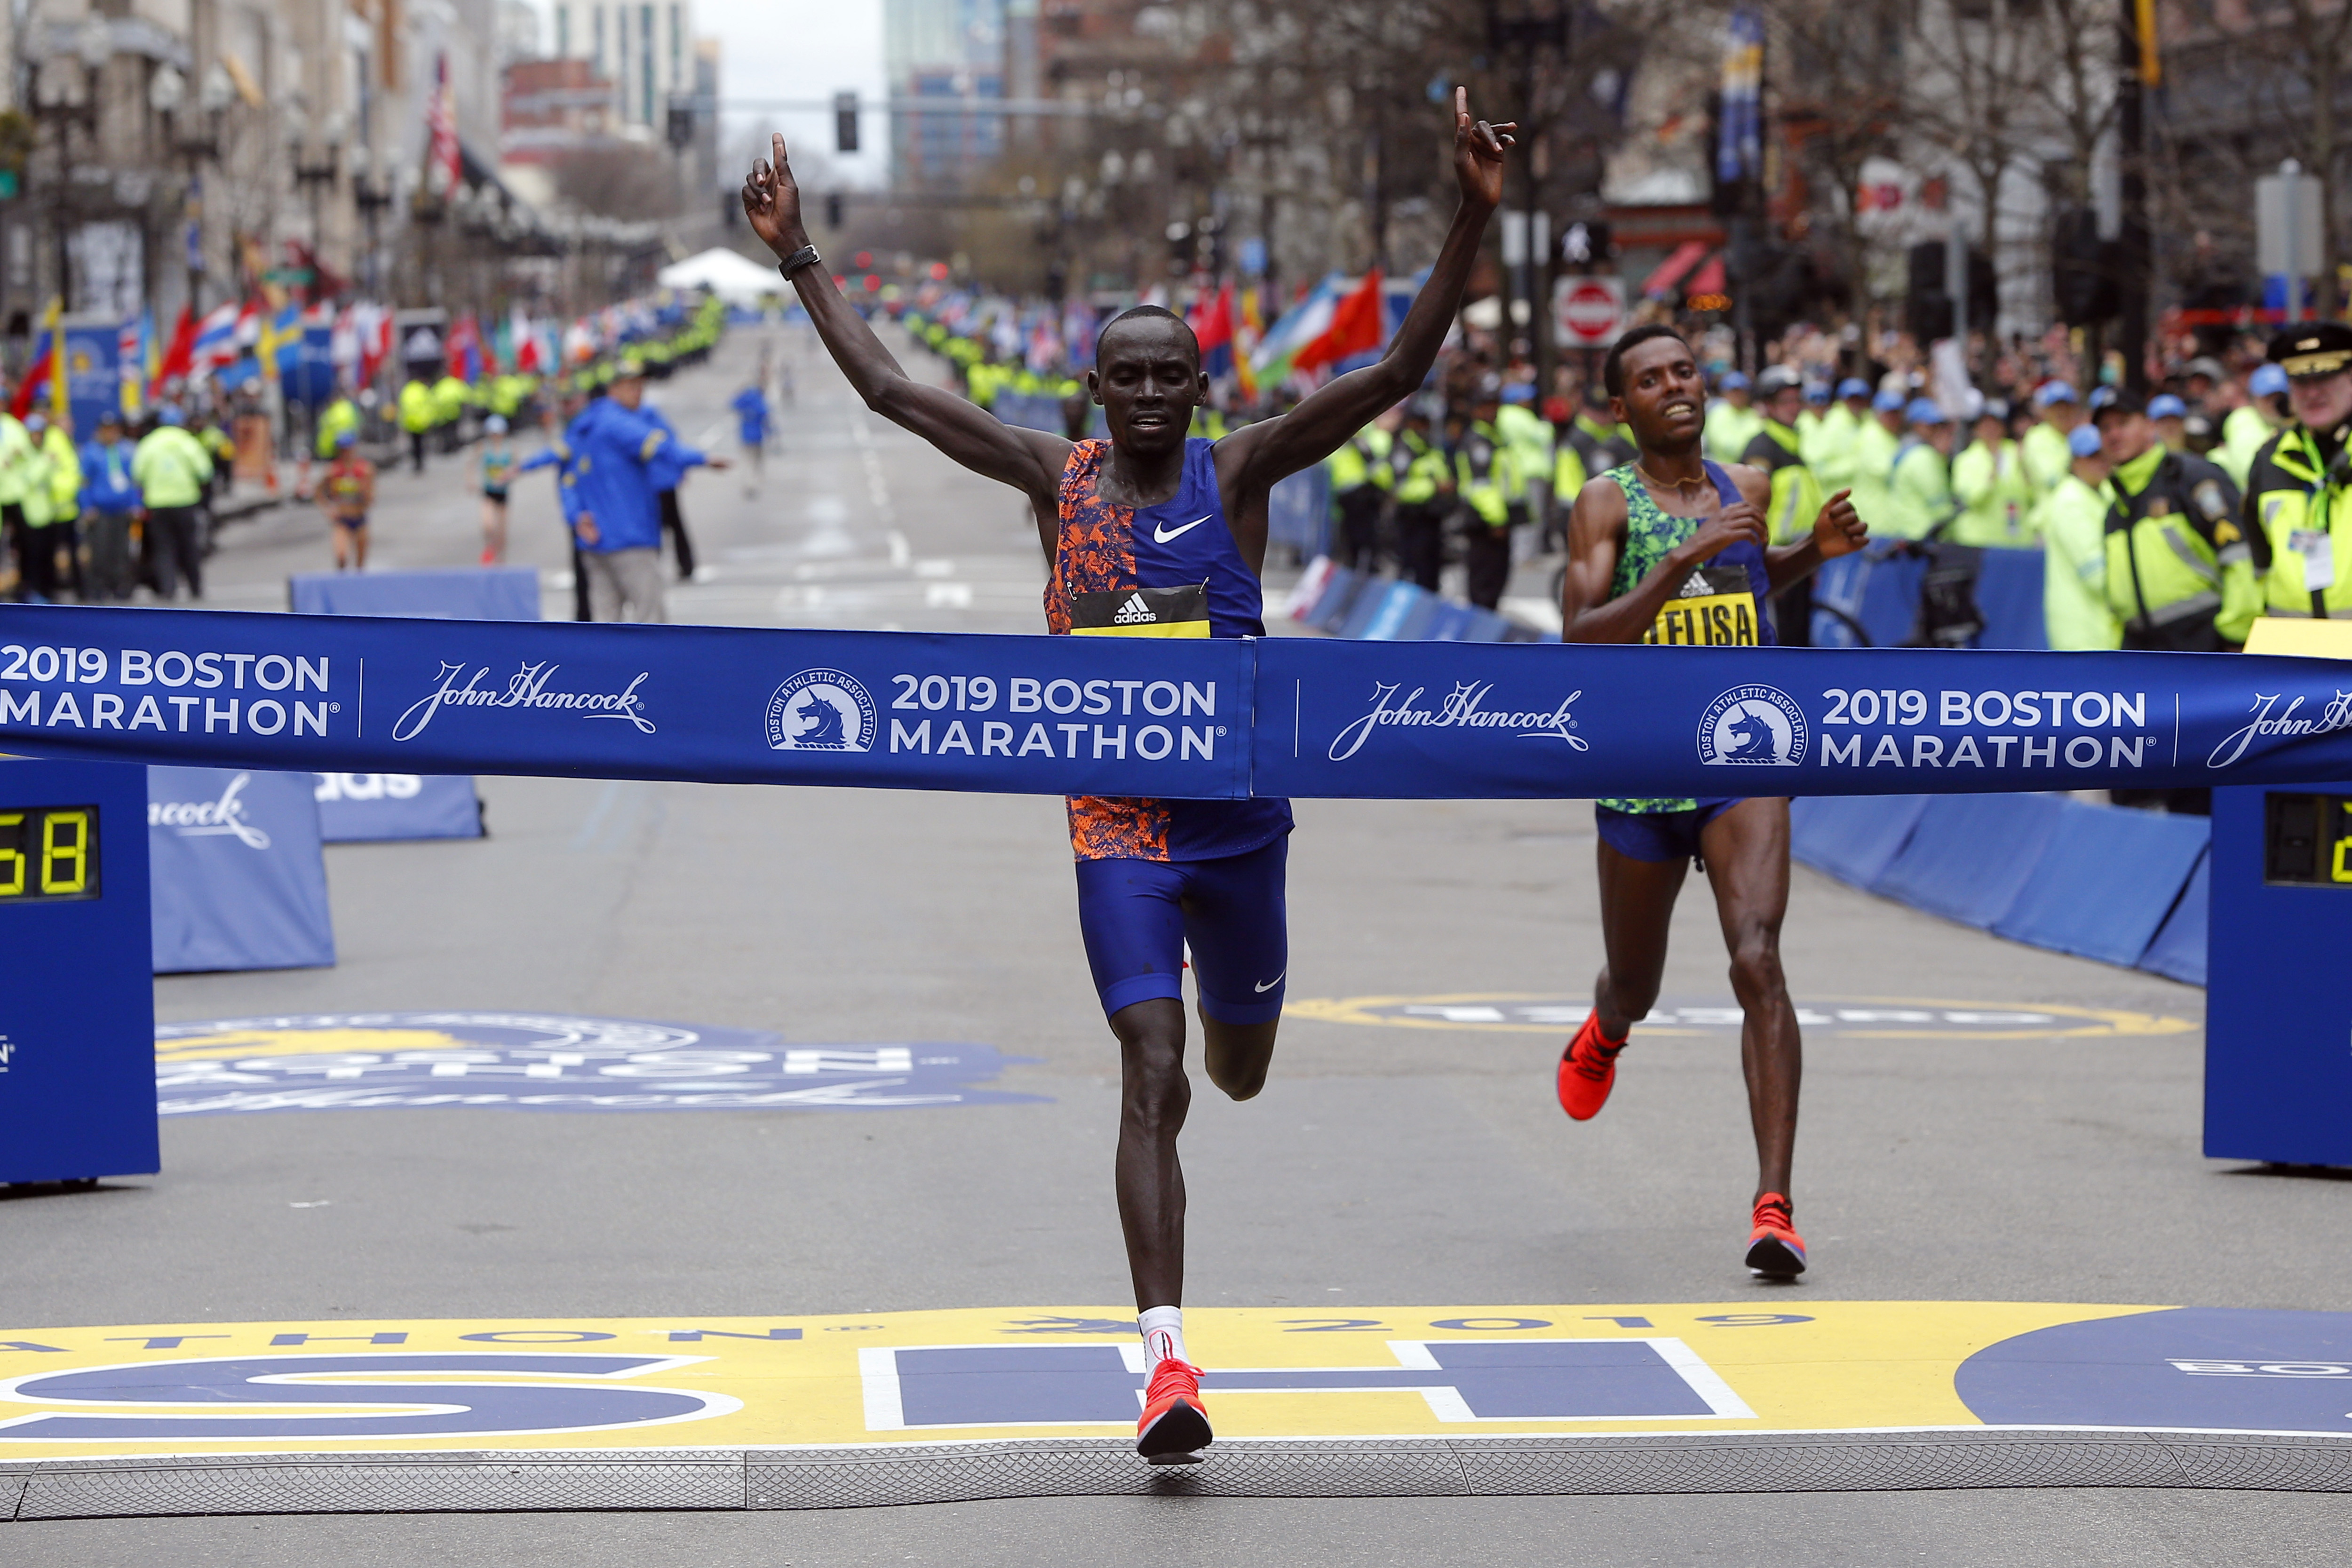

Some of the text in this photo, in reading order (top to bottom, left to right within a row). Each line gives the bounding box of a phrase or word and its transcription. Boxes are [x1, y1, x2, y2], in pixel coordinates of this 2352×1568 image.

[1114, 611, 1157, 624] adidas
[0, 645, 329, 692] 2019 BOSTON
[891, 674, 1216, 716] 2019 BOSTON
[392, 660, 497, 741] John
[769, 672, 874, 745] BOSTON ATHLETIC ASSOCIATION
[1328, 680, 1431, 761] John
[1701, 688, 1804, 759] BOSTON ATHLETIC ASSOCIATION
[1822, 689, 2145, 727] 2019 BOSTON
[2207, 692, 2313, 769] John
[1280, 1313, 1816, 1333] 2019
